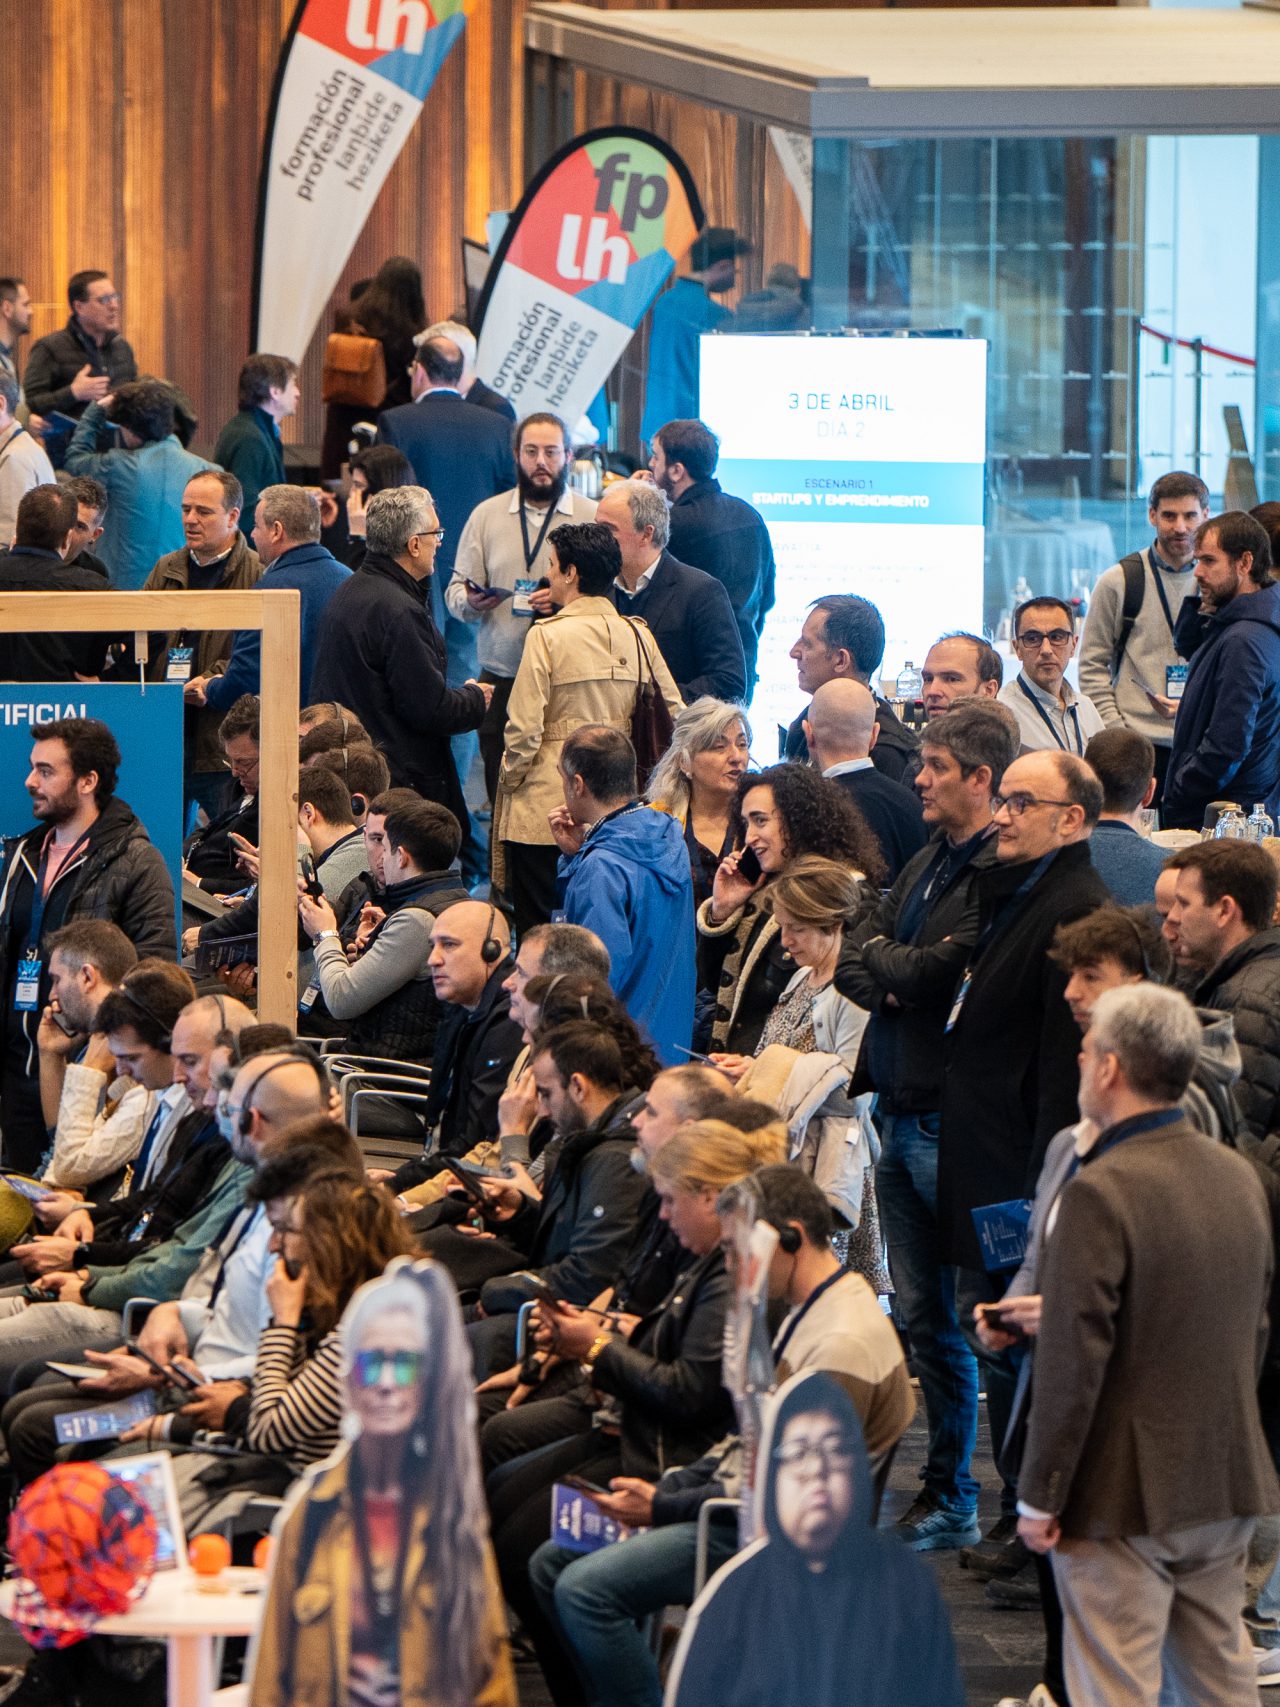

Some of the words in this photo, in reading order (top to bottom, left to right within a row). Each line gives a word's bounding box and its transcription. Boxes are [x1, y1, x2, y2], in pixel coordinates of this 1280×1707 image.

[280, 68, 346, 178] formación
[296, 76, 366, 202] profesional
[335, 91, 387, 171] lanbide
[345, 101, 403, 192] heziketa
[594, 153, 669, 232] fp
[556, 213, 630, 285] lh
[492, 300, 547, 389] ormación
[506, 308, 564, 403] rofesional
[534, 319, 583, 391] lanbide
[546, 328, 599, 408] heziketa
[788, 393, 799, 410] 3
[806, 393, 831, 410] DE
[839, 394, 895, 411] ABRIL
[855, 421, 865, 438] 2
[751, 493, 812, 506] STARTUPS
[814, 493, 824, 506] Y
[825, 494, 929, 508] EMPRENDIMIENTO
[804, 478, 866, 489] ESCENARIO
